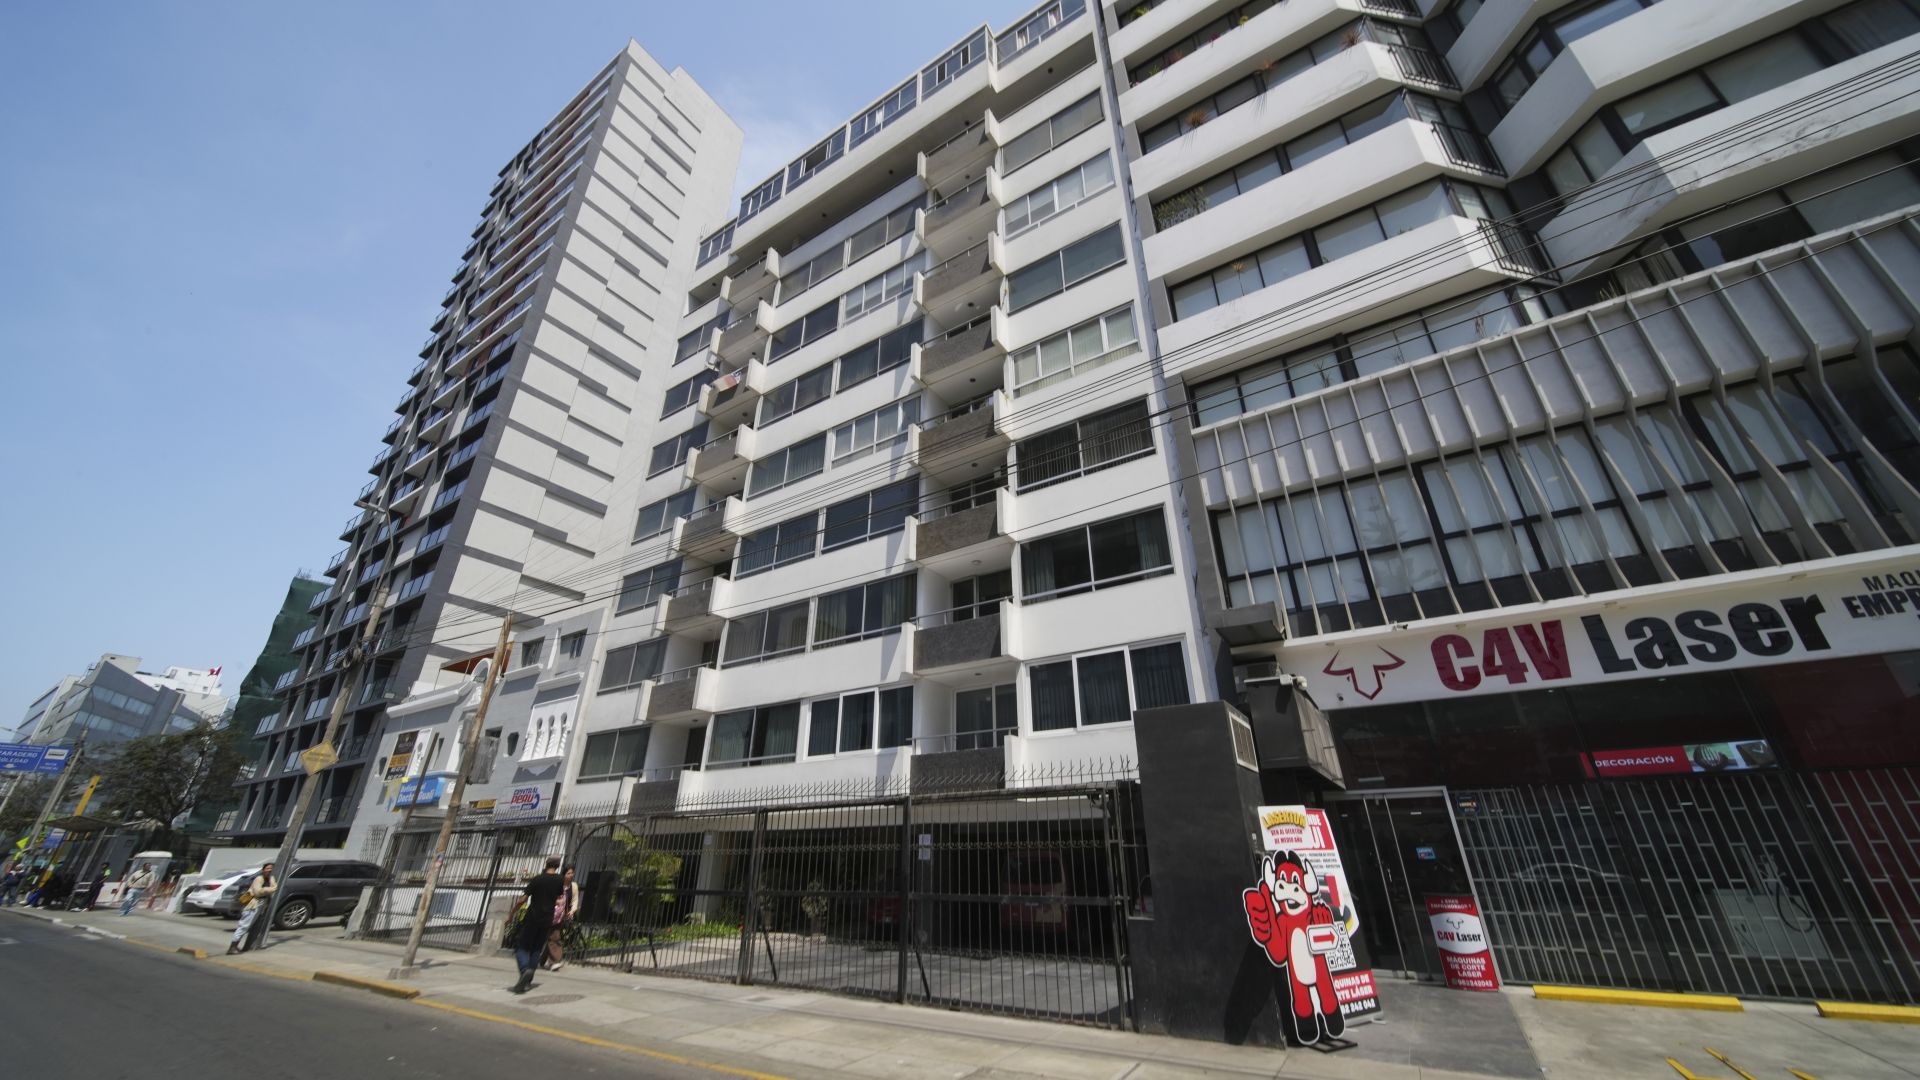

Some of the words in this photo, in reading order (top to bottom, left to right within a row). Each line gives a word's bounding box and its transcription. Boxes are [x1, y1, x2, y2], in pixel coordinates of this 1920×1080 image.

[1430, 619, 1572, 692] C4V
[1581, 593, 1832, 674] Laser
[1594, 755, 1675, 768] DECORACIÓN
[1437, 930, 1455, 941] C4V
[1456, 932, 1482, 942] Laser
[1461, 964, 1486, 972] CORTE
[1360, 974, 1370, 984] DE
[1350, 1000, 1364, 1013] 242
[1363, 998, 1376, 1010] 042
